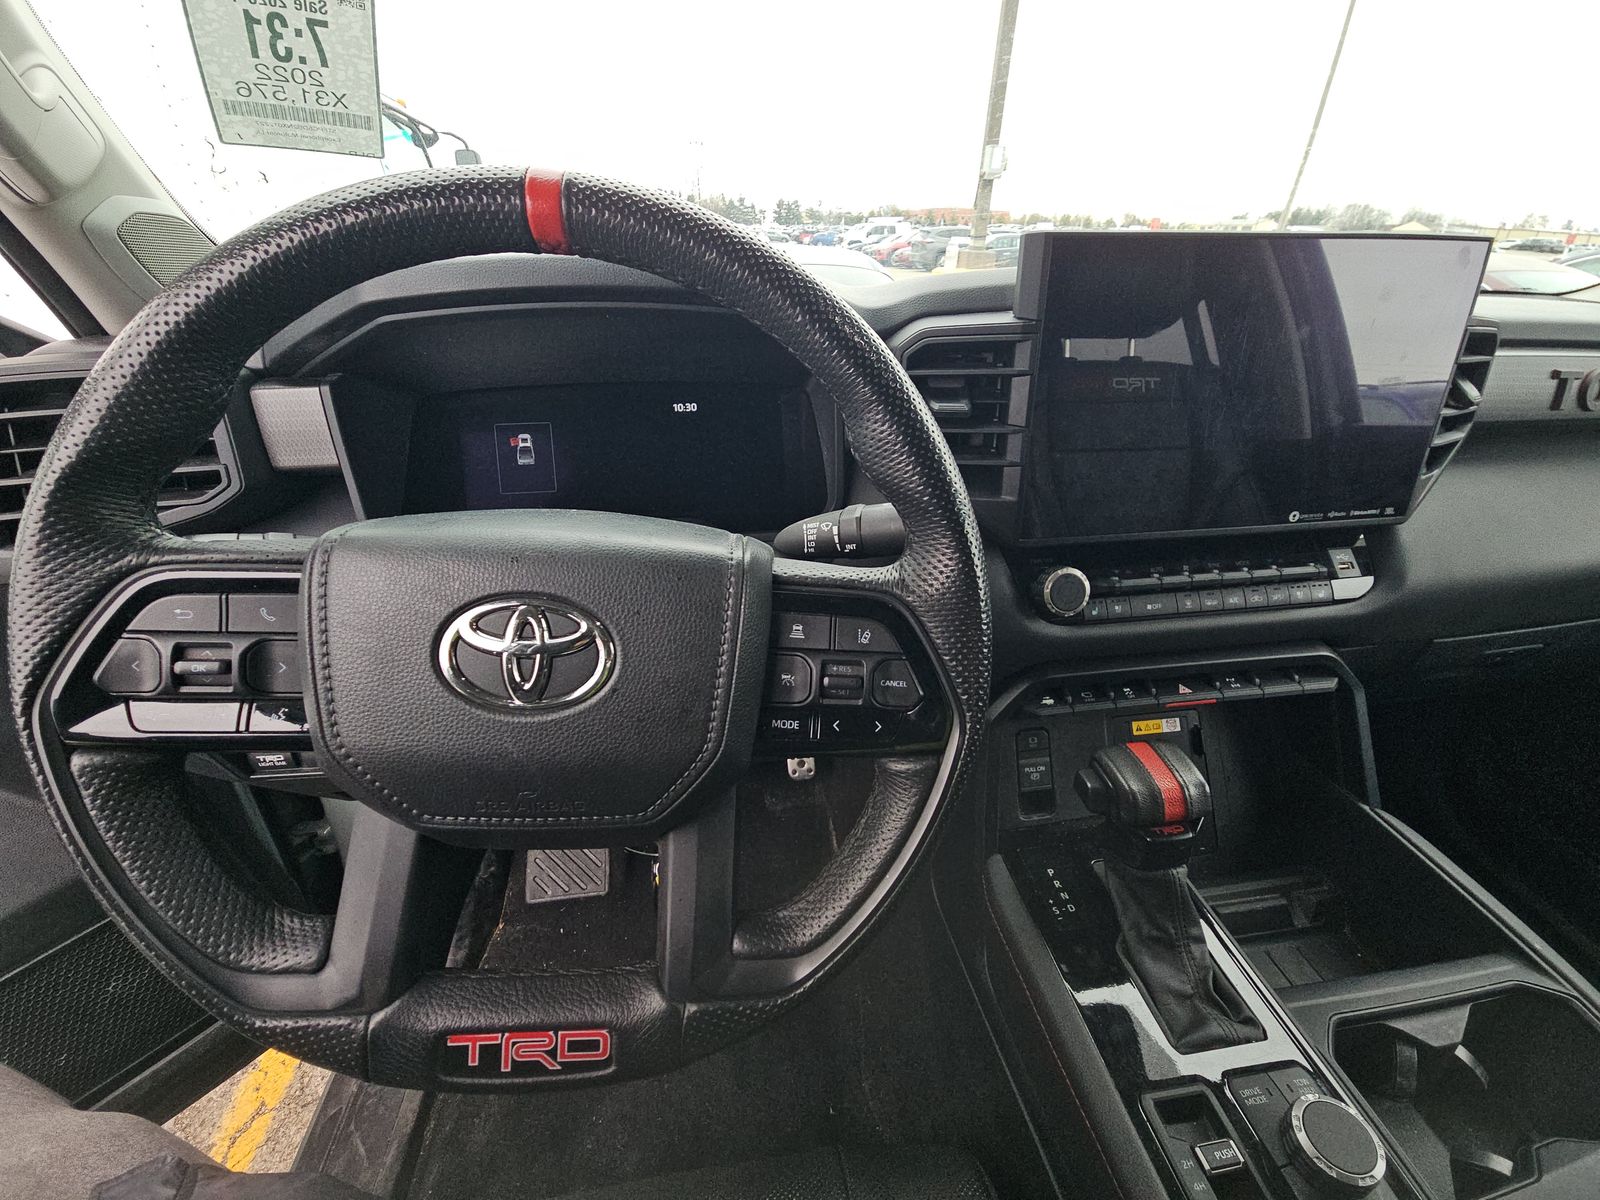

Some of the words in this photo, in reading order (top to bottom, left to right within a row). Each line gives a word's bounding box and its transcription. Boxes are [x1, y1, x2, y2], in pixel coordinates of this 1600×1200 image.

[672, 402, 698, 412] 10:30
[191, 664, 208, 672] OK
[880, 679, 908, 688] CANCEL
[771, 719, 800, 730] MODE
[255, 754, 285, 763] TRD
[1047, 868, 1055, 877] P
[1053, 880, 1062, 888] R
[1060, 891, 1069, 900] N
[1067, 904, 1076, 912] D
[446, 1029, 611, 1073] TRD
[1239, 1086, 1263, 1098] DRIVE
[1245, 1095, 1269, 1106] MODE
[1214, 1147, 1237, 1160] PUSH
[1181, 1160, 1195, 1169] 2H
[1193, 1181, 1207, 1191] 4H
